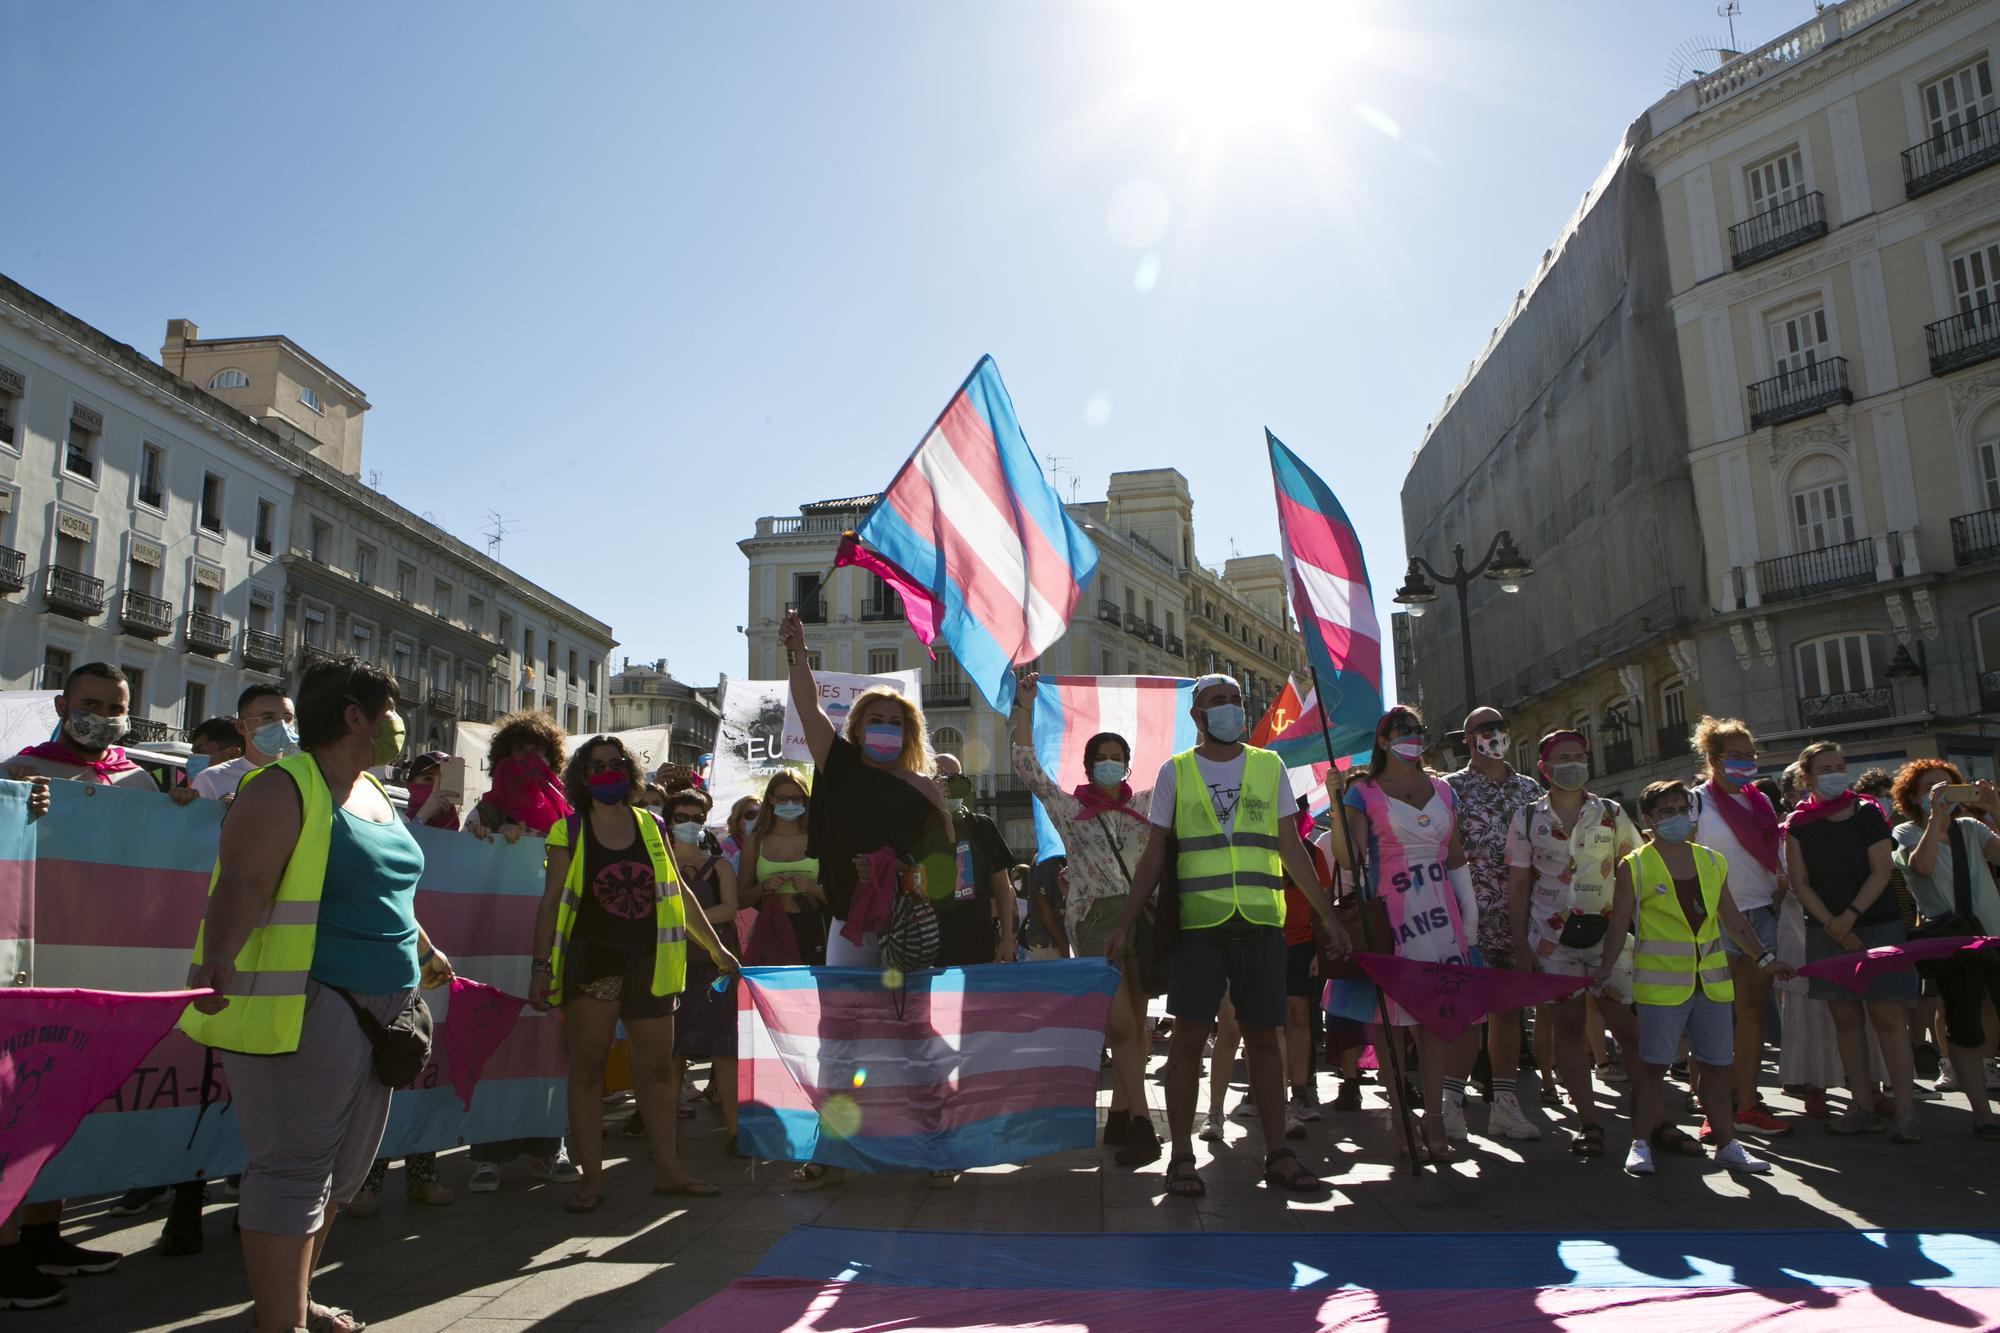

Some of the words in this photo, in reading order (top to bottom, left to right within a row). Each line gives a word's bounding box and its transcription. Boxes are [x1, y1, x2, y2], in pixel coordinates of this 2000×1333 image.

[62, 514, 90, 536] HOSTAL
[135, 543, 160, 559] RIESCO
[198, 567, 219, 583] HOSTAL
[748, 735, 783, 761] EU
